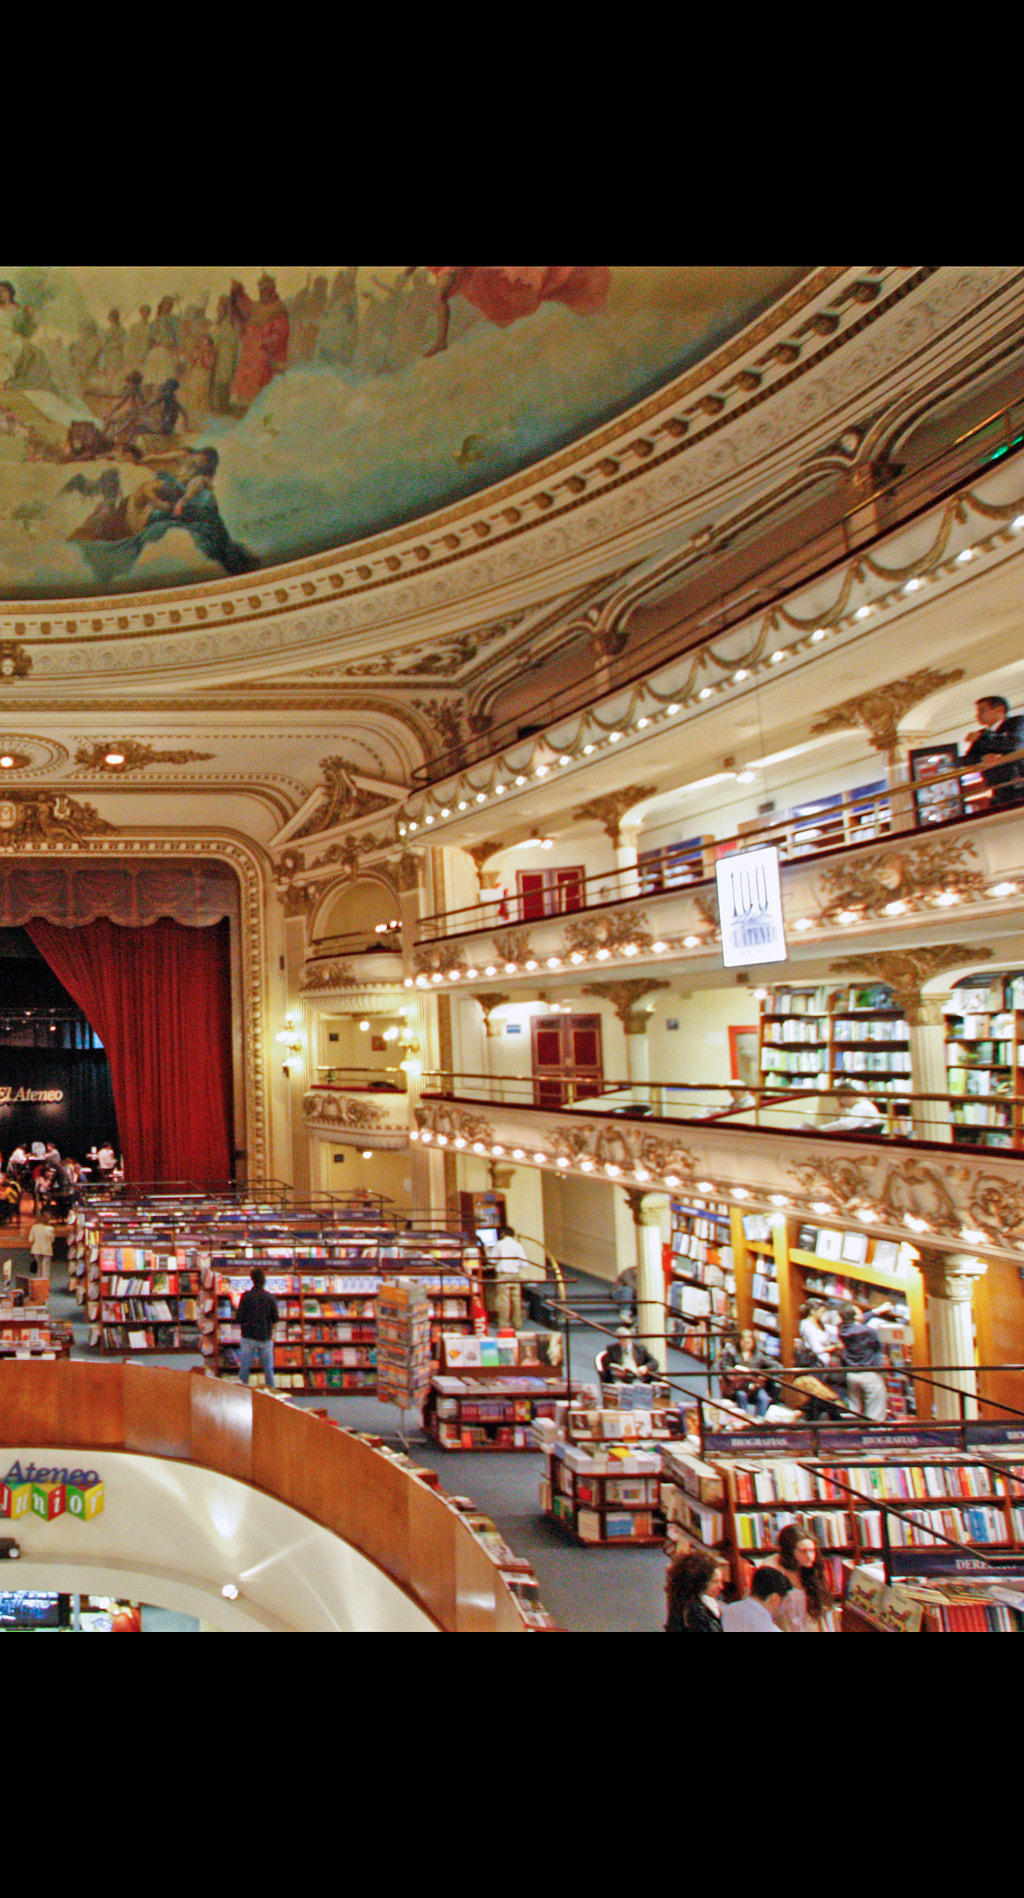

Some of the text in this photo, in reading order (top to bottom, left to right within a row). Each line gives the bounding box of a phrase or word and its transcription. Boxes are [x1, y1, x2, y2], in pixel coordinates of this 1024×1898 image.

[13, 1086, 64, 1101] Ateneo
[731, 1437, 788, 1447] BIOGRAFIAS
[862, 1435, 919, 1445] BIOGRAFIAS
[3, 1459, 99, 1487] Ateneo
[0, 1488, 102, 1515] Junior
